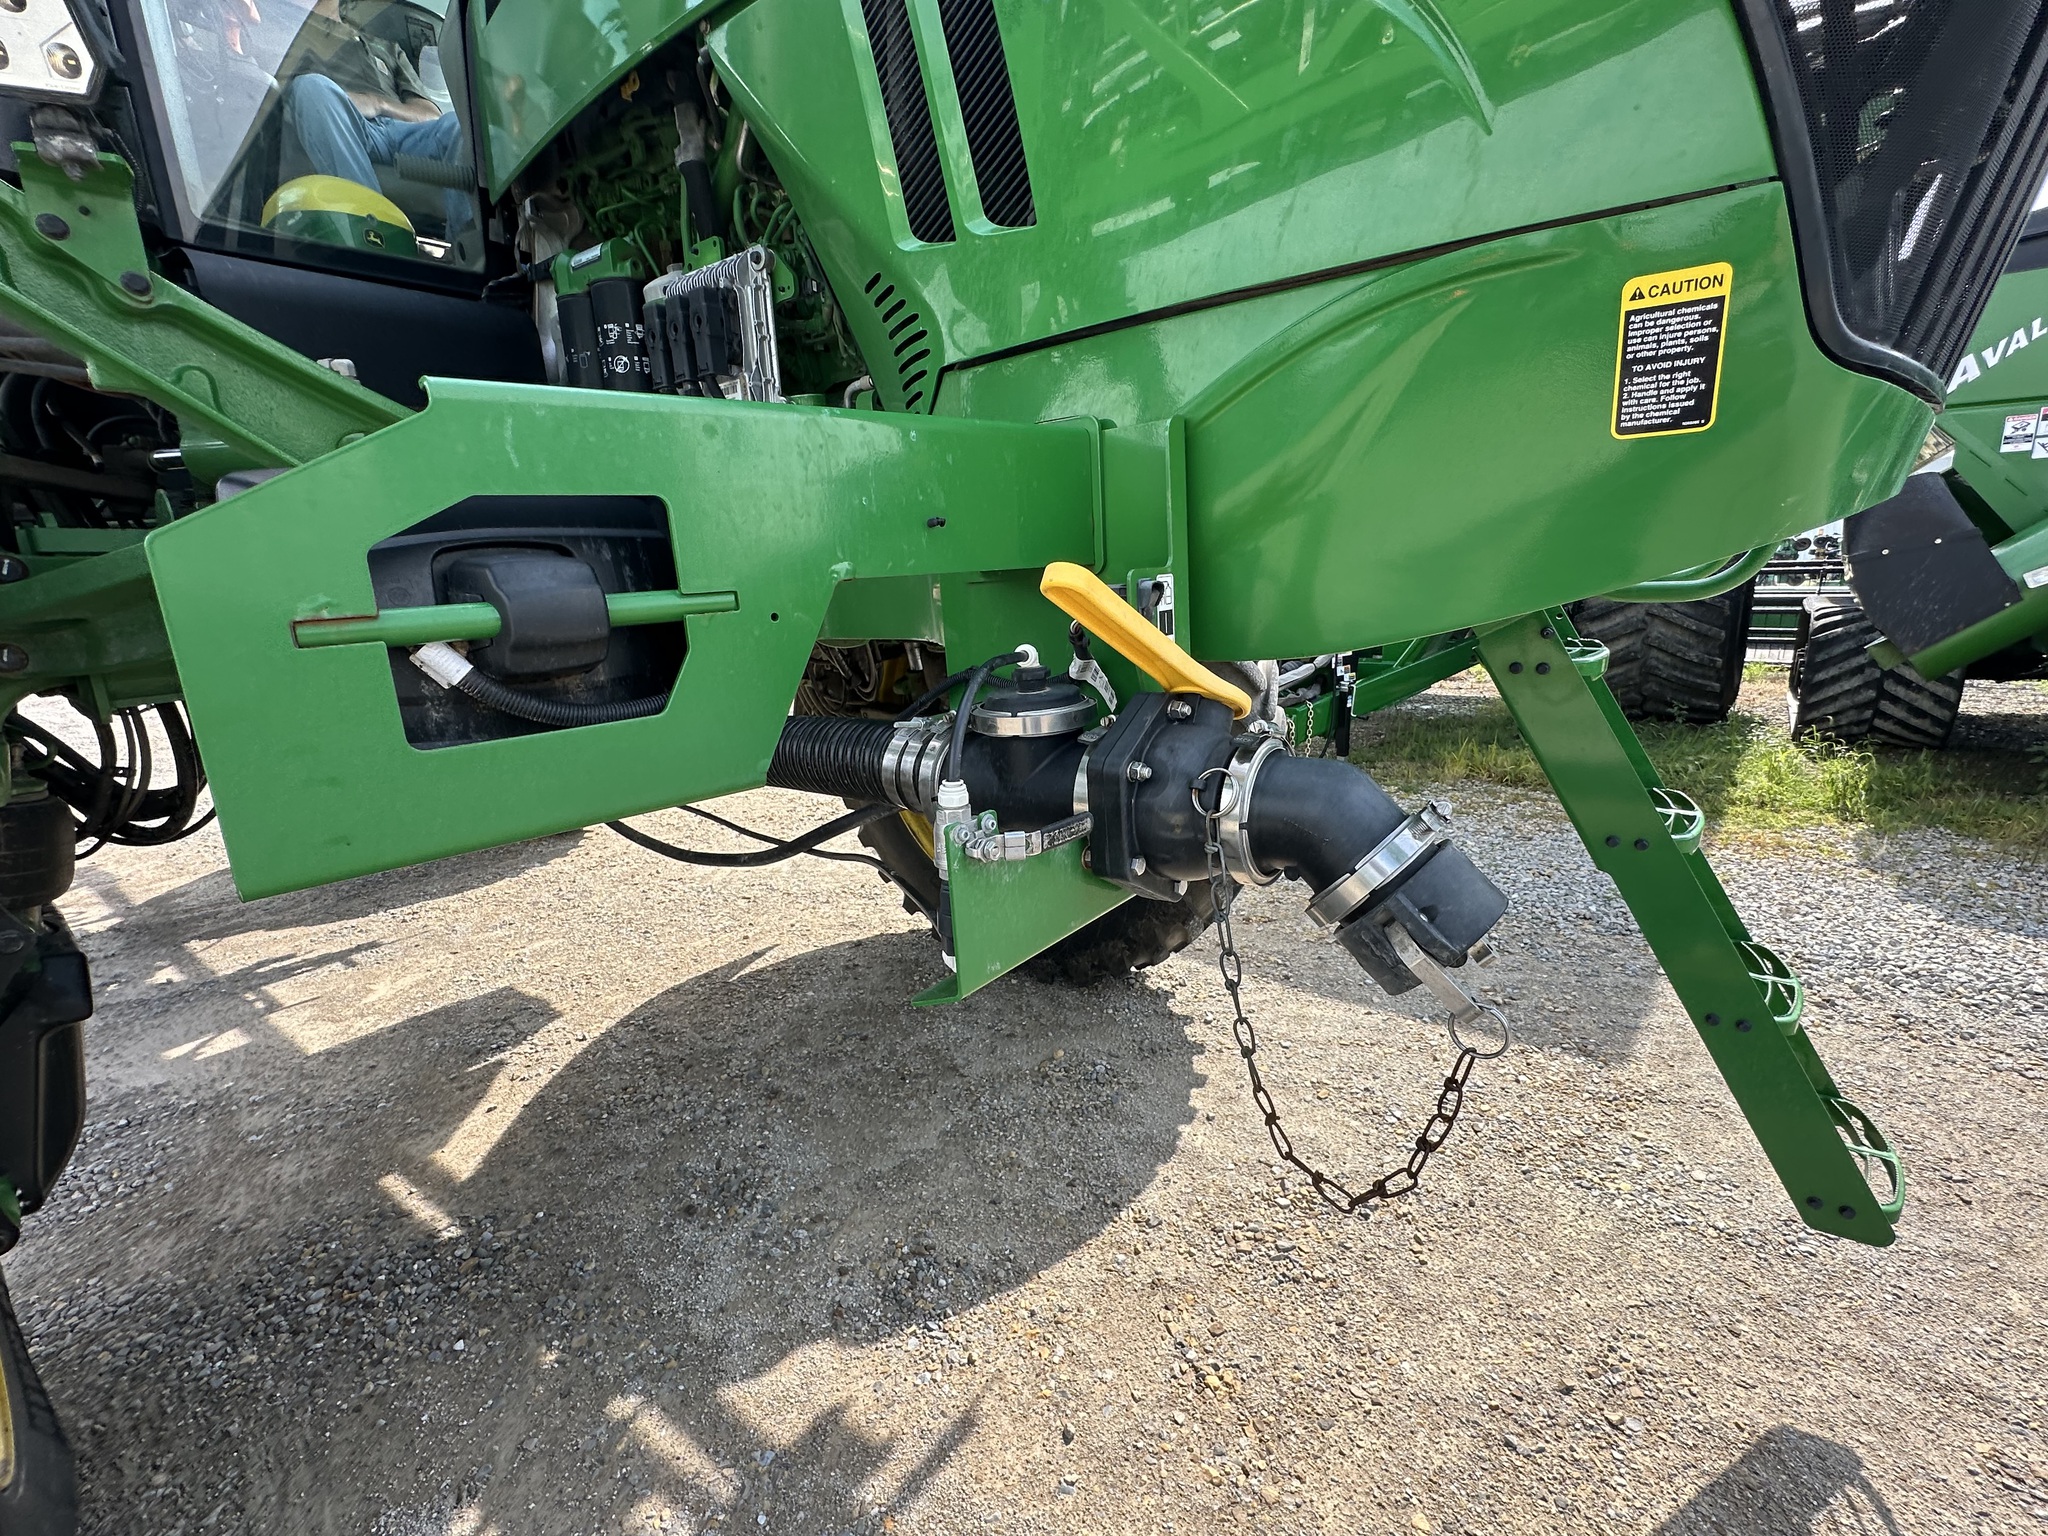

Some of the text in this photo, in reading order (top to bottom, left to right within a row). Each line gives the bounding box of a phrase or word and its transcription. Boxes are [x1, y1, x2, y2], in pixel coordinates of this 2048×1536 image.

[1648, 274, 1724, 298] CAUTION
[1629, 303, 1718, 322] Agricultural chemicals
[1628, 322, 1643, 330] can
[1656, 315, 1701, 326] dangerous.
[1628, 326, 1664, 338] Improper
[1665, 321, 1701, 332] selection
[1627, 326, 1719, 345] use can injure persons,
[1626, 335, 1709, 353] animals, plants, soils
[1635, 349, 1657, 358] other
[1658, 345, 1694, 357] property.
[1946, 317, 2048, 395] AVAL
[1631, 356, 1706, 373] TO AVOID INJURY
[1623, 382, 1657, 392] chemical
[1659, 380, 1671, 388] for
[1685, 377, 1701, 386] job.
[1632, 375, 1657, 384] Select
[1657, 373, 1671, 381] the
[1672, 370, 1691, 380] right
[1631, 389, 1658, 398] Handle
[1659, 387, 1675, 395] and
[1676, 384, 1698, 395] apply
[1660, 393, 1687, 402] Follow
[1621, 399, 1695, 414] instructions issued
[1620, 408, 1681, 422] by the chemical
[1620, 416, 1673, 428] manufacturer.
